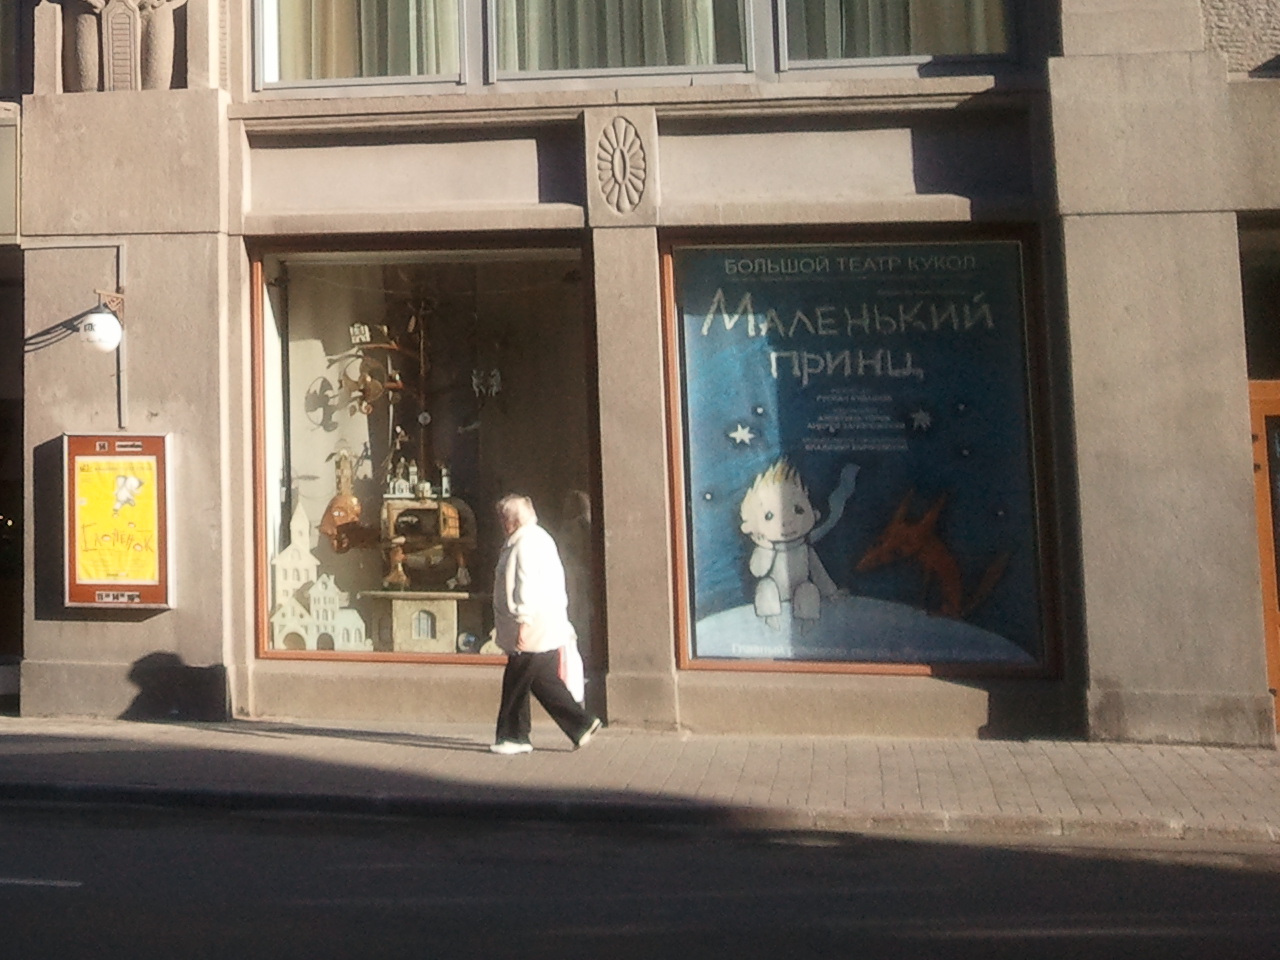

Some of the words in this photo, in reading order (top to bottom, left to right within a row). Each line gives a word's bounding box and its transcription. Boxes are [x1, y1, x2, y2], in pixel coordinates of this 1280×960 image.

[724, 256, 830, 276] БОЛЬШОЙ
[836, 256, 901, 273] ТЕАТР
[907, 254, 977, 272] КУКОЛ
